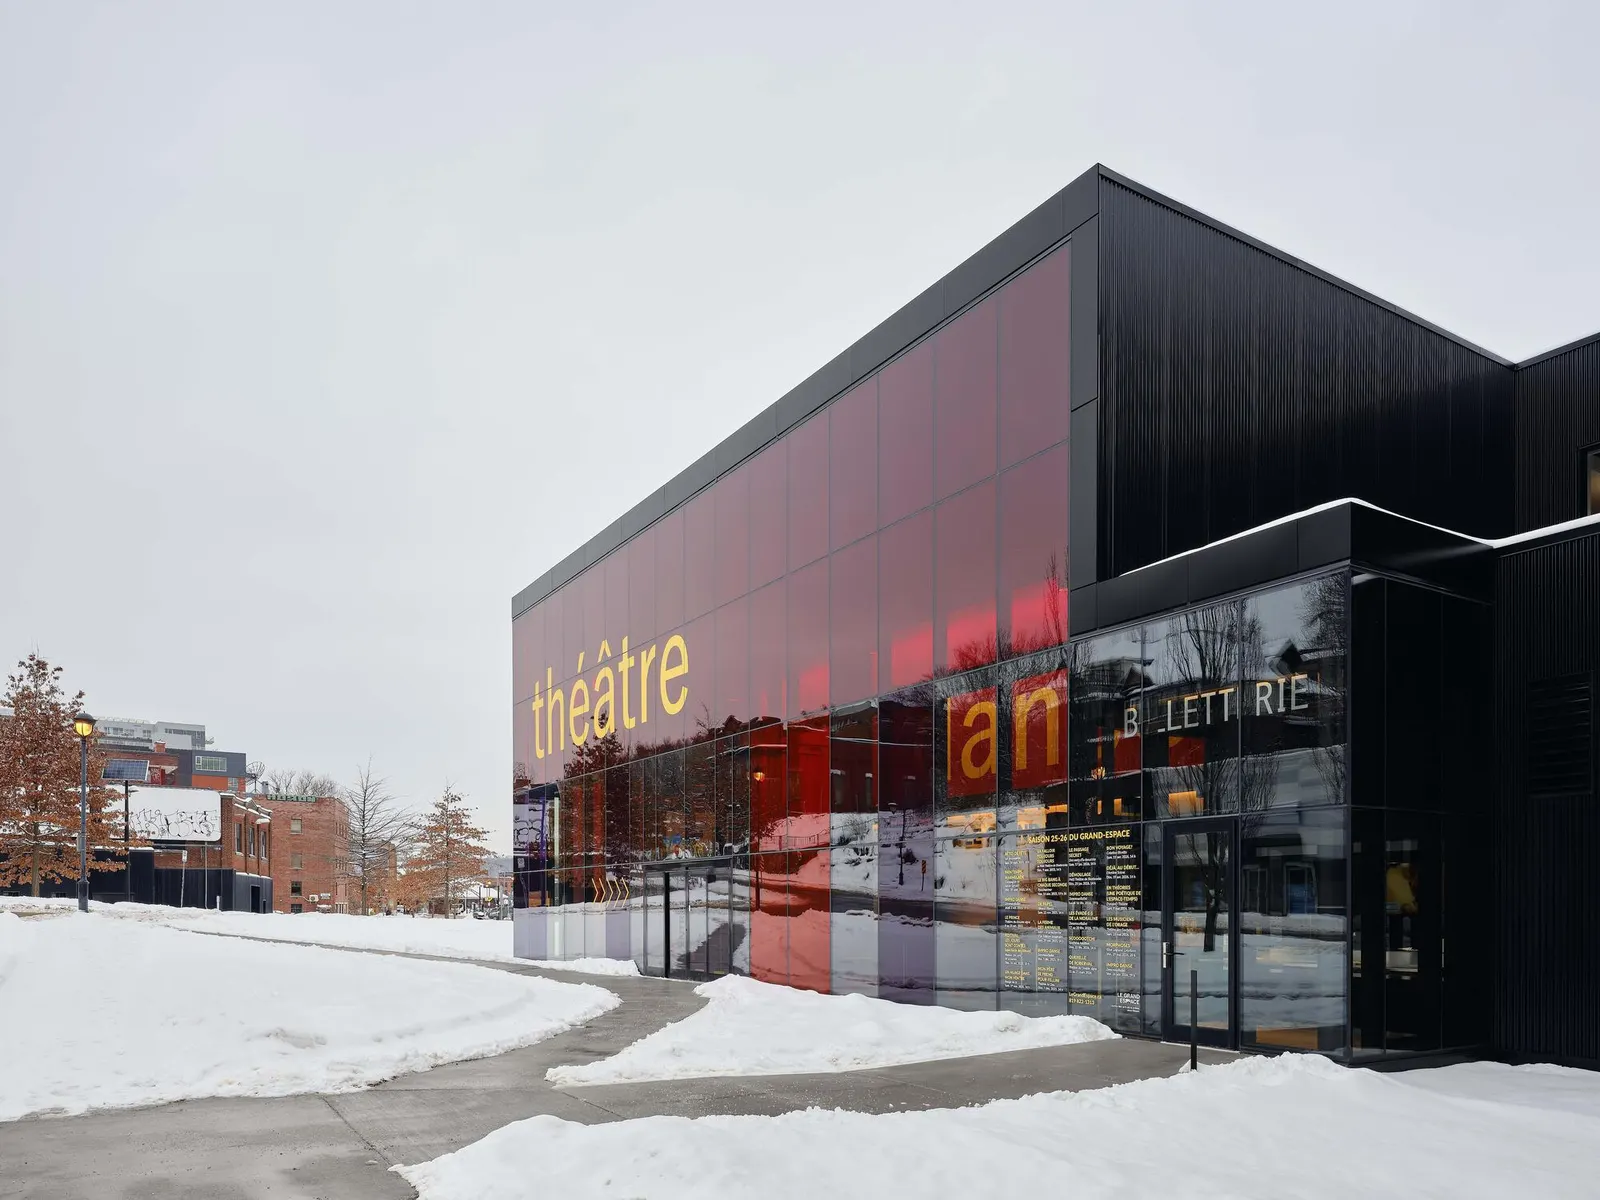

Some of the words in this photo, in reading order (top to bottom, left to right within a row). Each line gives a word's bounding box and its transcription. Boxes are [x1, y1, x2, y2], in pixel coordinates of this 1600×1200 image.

[532, 634, 689, 759] théâtre
[1124, 674, 1309, 739] BLETTRIE
[1028, 835, 1050, 844] SAISON
[1050, 834, 1068, 843] 25-26
[1069, 833, 1079, 841] DU
[1080, 830, 1130, 840] GRAND-ESPACE
